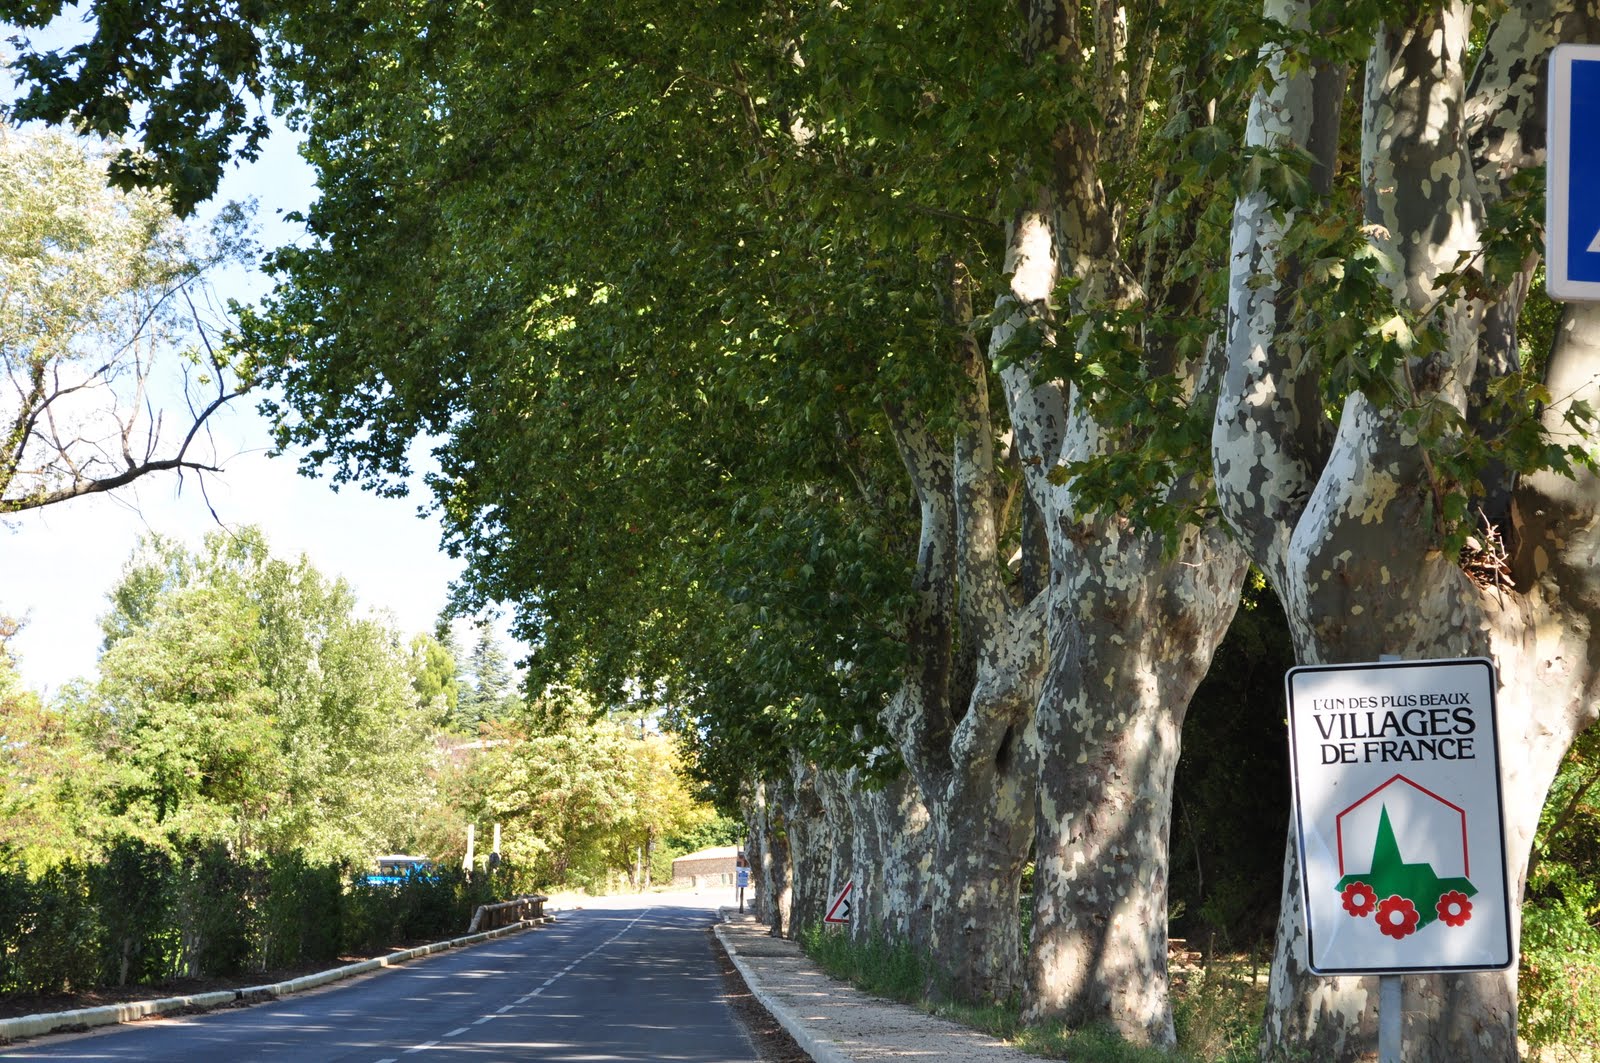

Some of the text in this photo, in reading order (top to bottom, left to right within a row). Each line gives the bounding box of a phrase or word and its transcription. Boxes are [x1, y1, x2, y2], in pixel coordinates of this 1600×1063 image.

[1313, 692, 1471, 711] L'UN DES PLUS BEAUX
[1313, 707, 1476, 740] VILLAGES
[1321, 738, 1476, 765] DE FRANCE
